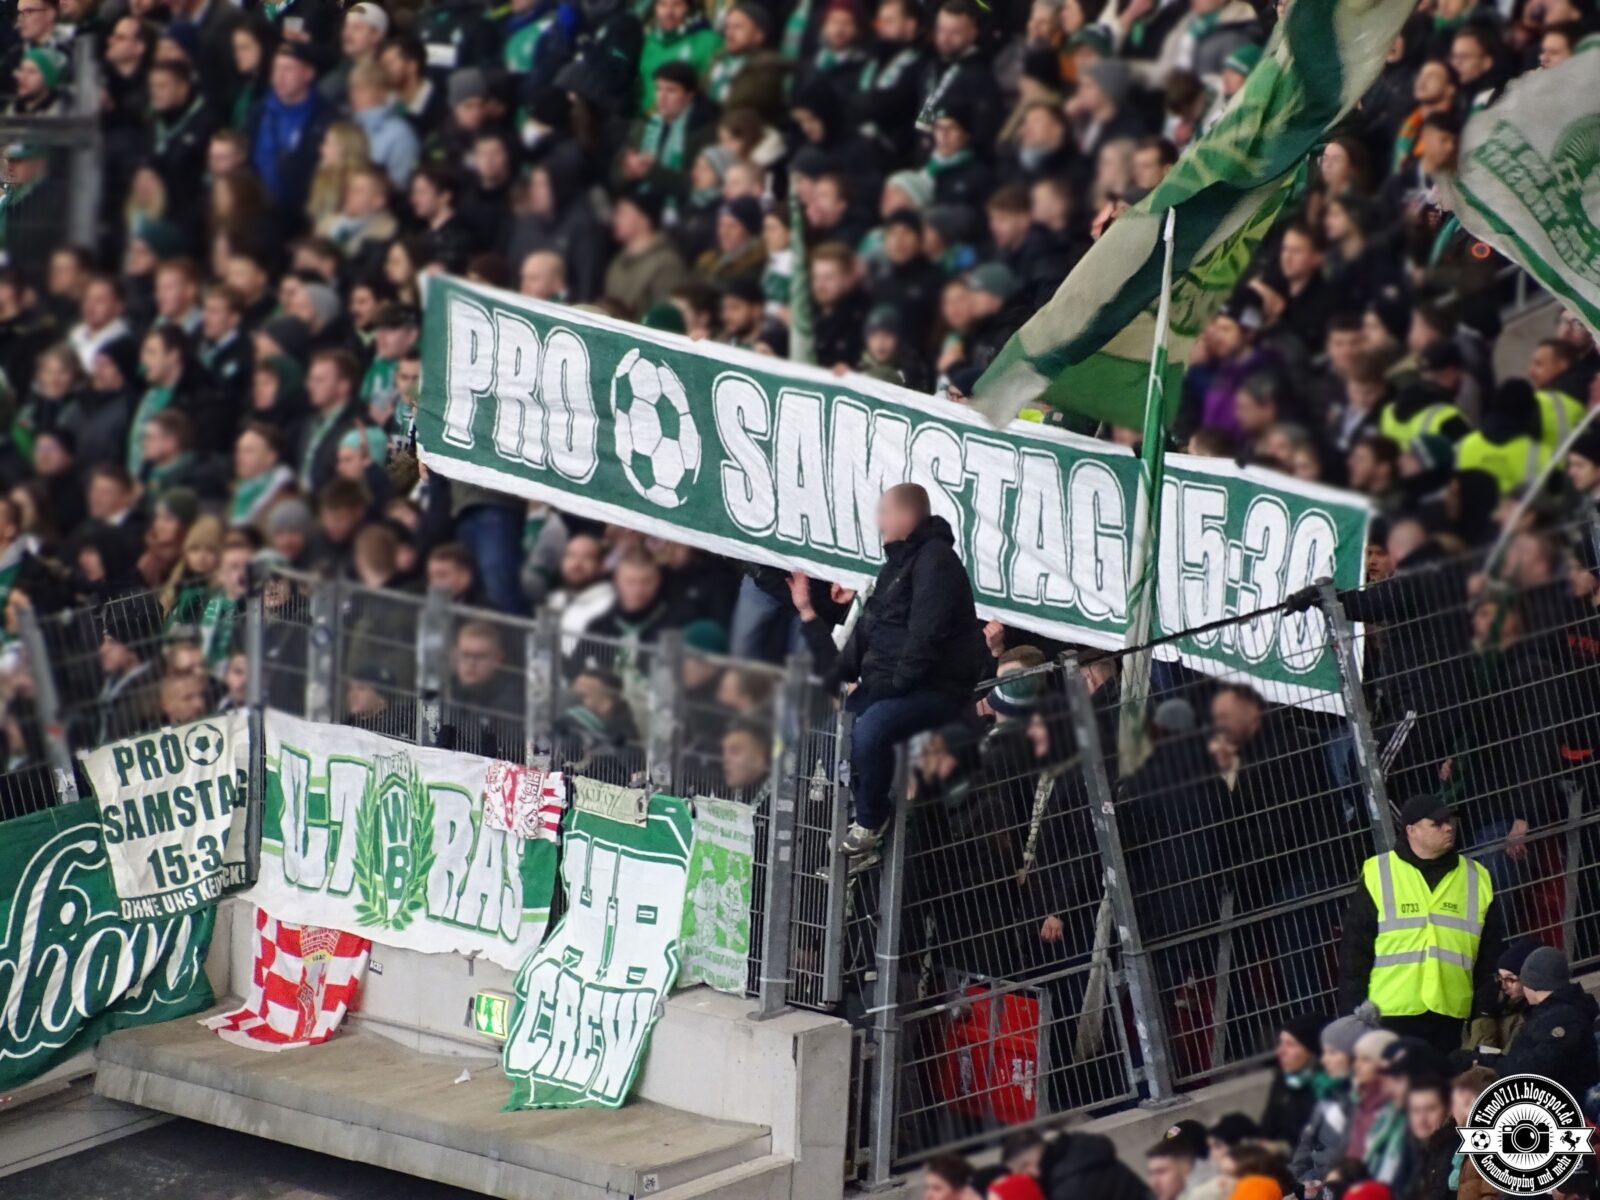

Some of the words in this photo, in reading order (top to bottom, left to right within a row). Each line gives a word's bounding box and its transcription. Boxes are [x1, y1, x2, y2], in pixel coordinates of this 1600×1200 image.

[442, 296, 599, 485] PRO
[712, 371, 1128, 622] SAMSTAG
[1156, 475, 1338, 674] 15:30
[113, 733, 184, 786] PRO
[147, 827, 231, 888] 15:3
[121, 896, 162, 919] OHNE
[162, 888, 198, 913] UNS
[1401, 903, 1420, 913] 0733
[503, 955, 661, 1107] CREW
